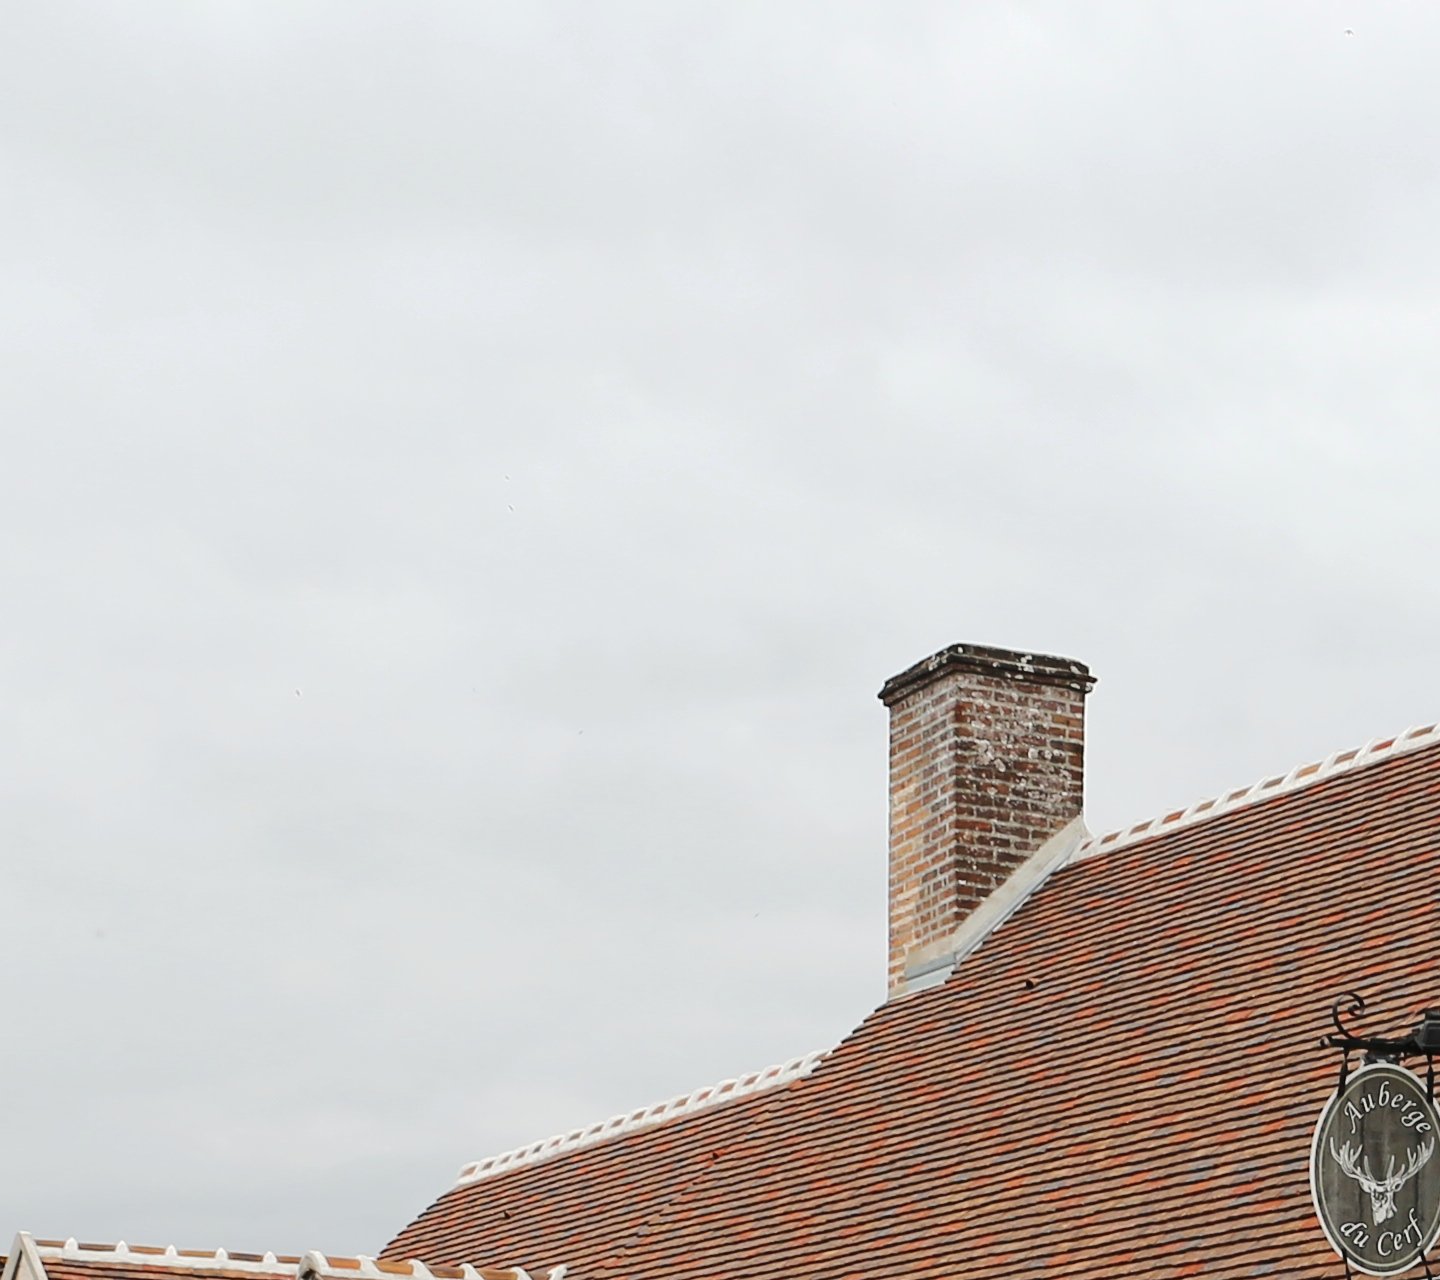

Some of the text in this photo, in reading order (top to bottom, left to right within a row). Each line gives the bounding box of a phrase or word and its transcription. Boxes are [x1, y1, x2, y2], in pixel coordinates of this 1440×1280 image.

[1344, 1081, 1432, 1134] Auberge
[1340, 1208, 1423, 1256] du Cerf
